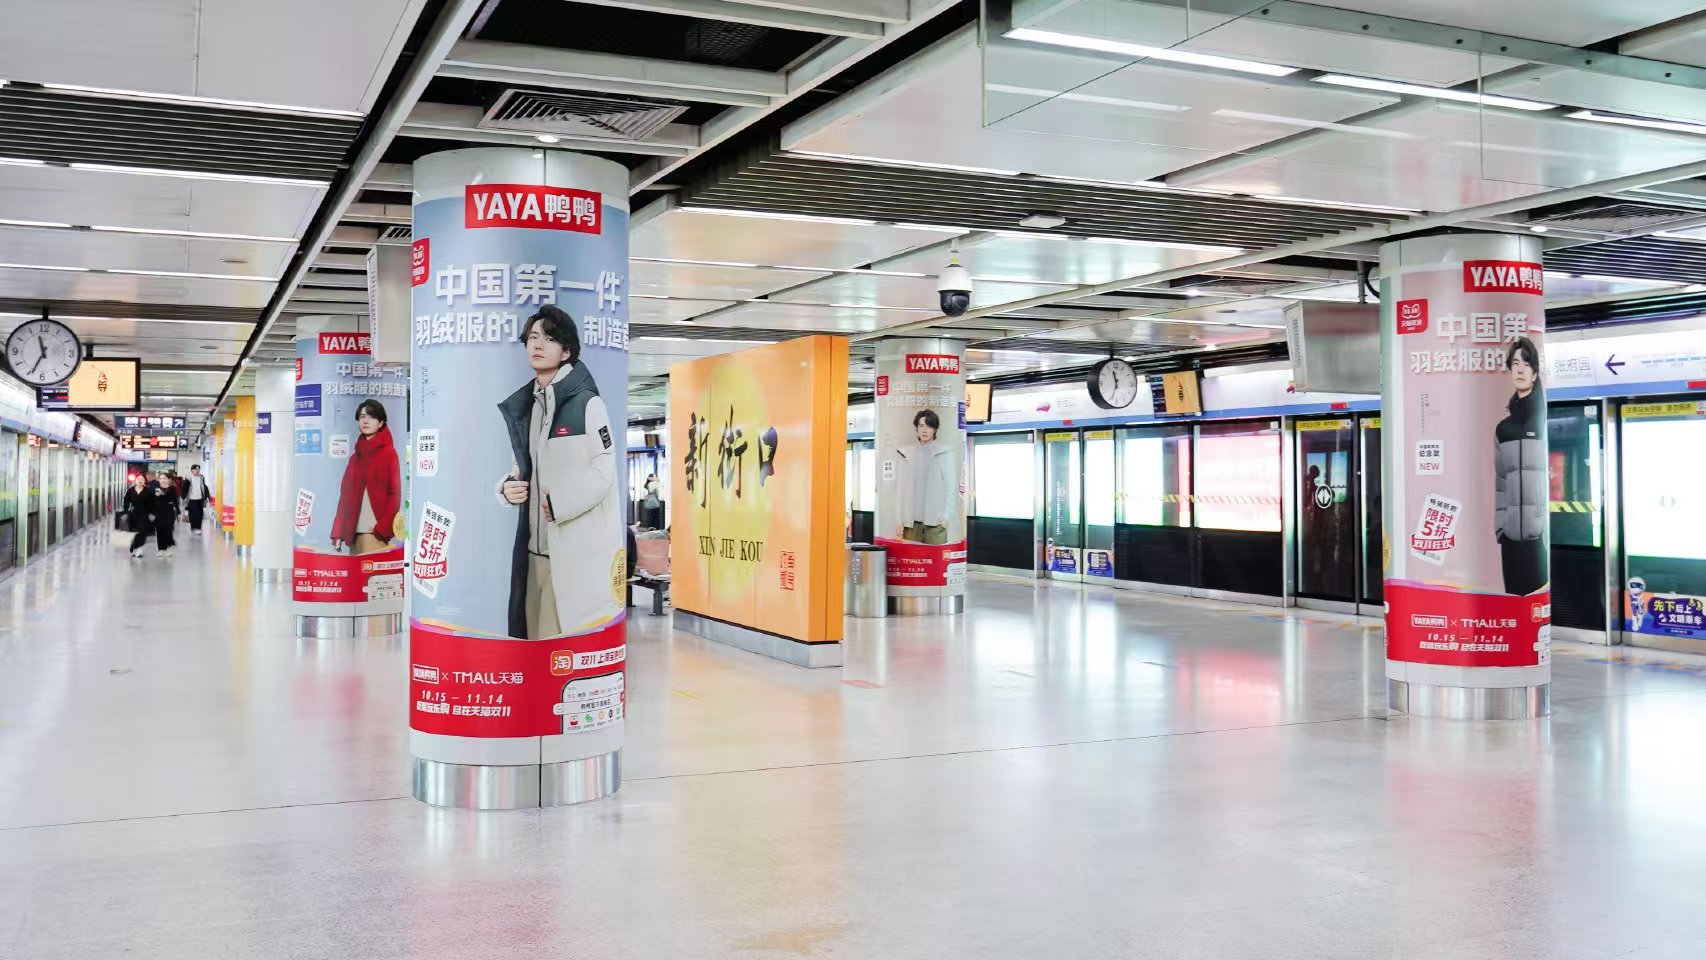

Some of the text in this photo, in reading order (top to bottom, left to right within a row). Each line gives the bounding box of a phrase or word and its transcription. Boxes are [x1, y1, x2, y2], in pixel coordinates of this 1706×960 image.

[472, 193, 596, 226] YAYA鸭鸭
[1470, 266, 1543, 290] YAYA鸭鸭
[435, 263, 621, 312] 中国第一件
[39, 324, 50, 333] 12
[415, 311, 519, 346] 羽绒服的
[12, 347, 19, 356] 9
[68, 349, 75, 358] 3
[1408, 349, 1508, 374] 羽绒服的
[39, 372, 46, 381] 6
[419, 459, 435, 470] NEW
[685, 404, 778, 509] 新街口
[1419, 462, 1440, 471] NEW
[1425, 507, 1454, 527] 限时
[423, 520, 447, 546] 限时
[1421, 520, 1449, 540] 5折
[419, 538, 442, 564] 5折
[698, 535, 763, 562] XIN JIE KOU
[1654, 600, 1692, 614] 先下后上
[1460, 618, 1517, 628] TMALL天猫
[1427, 633, 1455, 642] 10.15
[1473, 634, 1504, 643] 11.14
[553, 655, 571, 670] 淘
[451, 671, 524, 684] TMALL天猫
[421, 689, 447, 702] 10.15
[466, 693, 504, 705] 11.14
